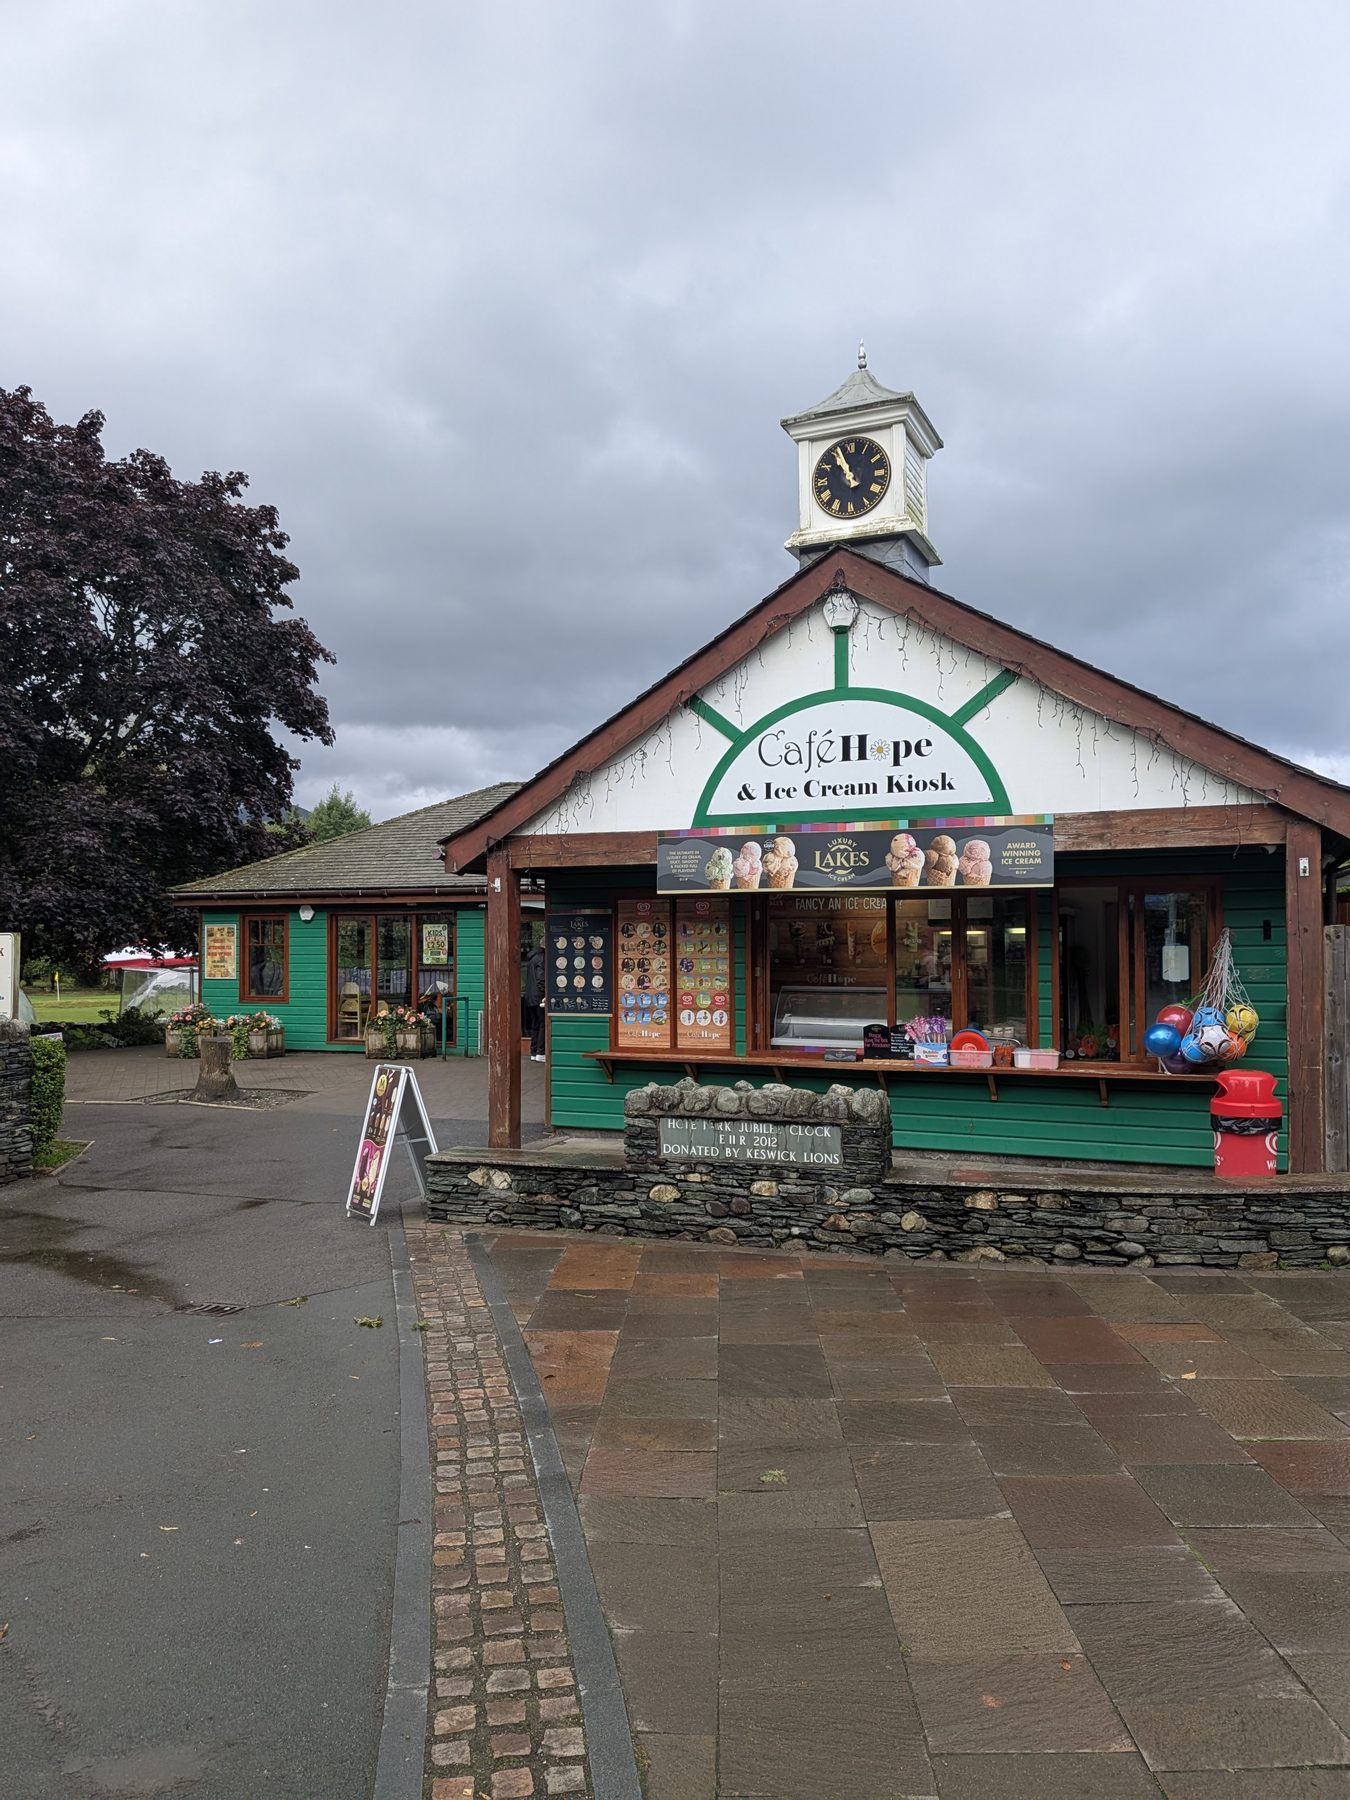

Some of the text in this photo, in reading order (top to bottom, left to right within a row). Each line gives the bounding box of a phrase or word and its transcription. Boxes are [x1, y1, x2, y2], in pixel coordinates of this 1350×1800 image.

[758, 728, 933, 773] Café Hope
[737, 772, 956, 801] & Ice Cream Kiosk
[827, 837, 857, 848] LUXURY
[814, 850, 870, 872] LAKES
[837, 872, 856, 882] CREAM
[795, 898, 824, 910] FANCY
[828, 898, 841, 910] AN
[845, 898, 858, 910] ICE
[703, 1120, 732, 1131] RK
[789, 1125, 831, 1137] CLOCK
[719, 1135, 778, 1147] E II R 2012
[663, 1144, 840, 1164] DONATED BY KESWICK LIONS
